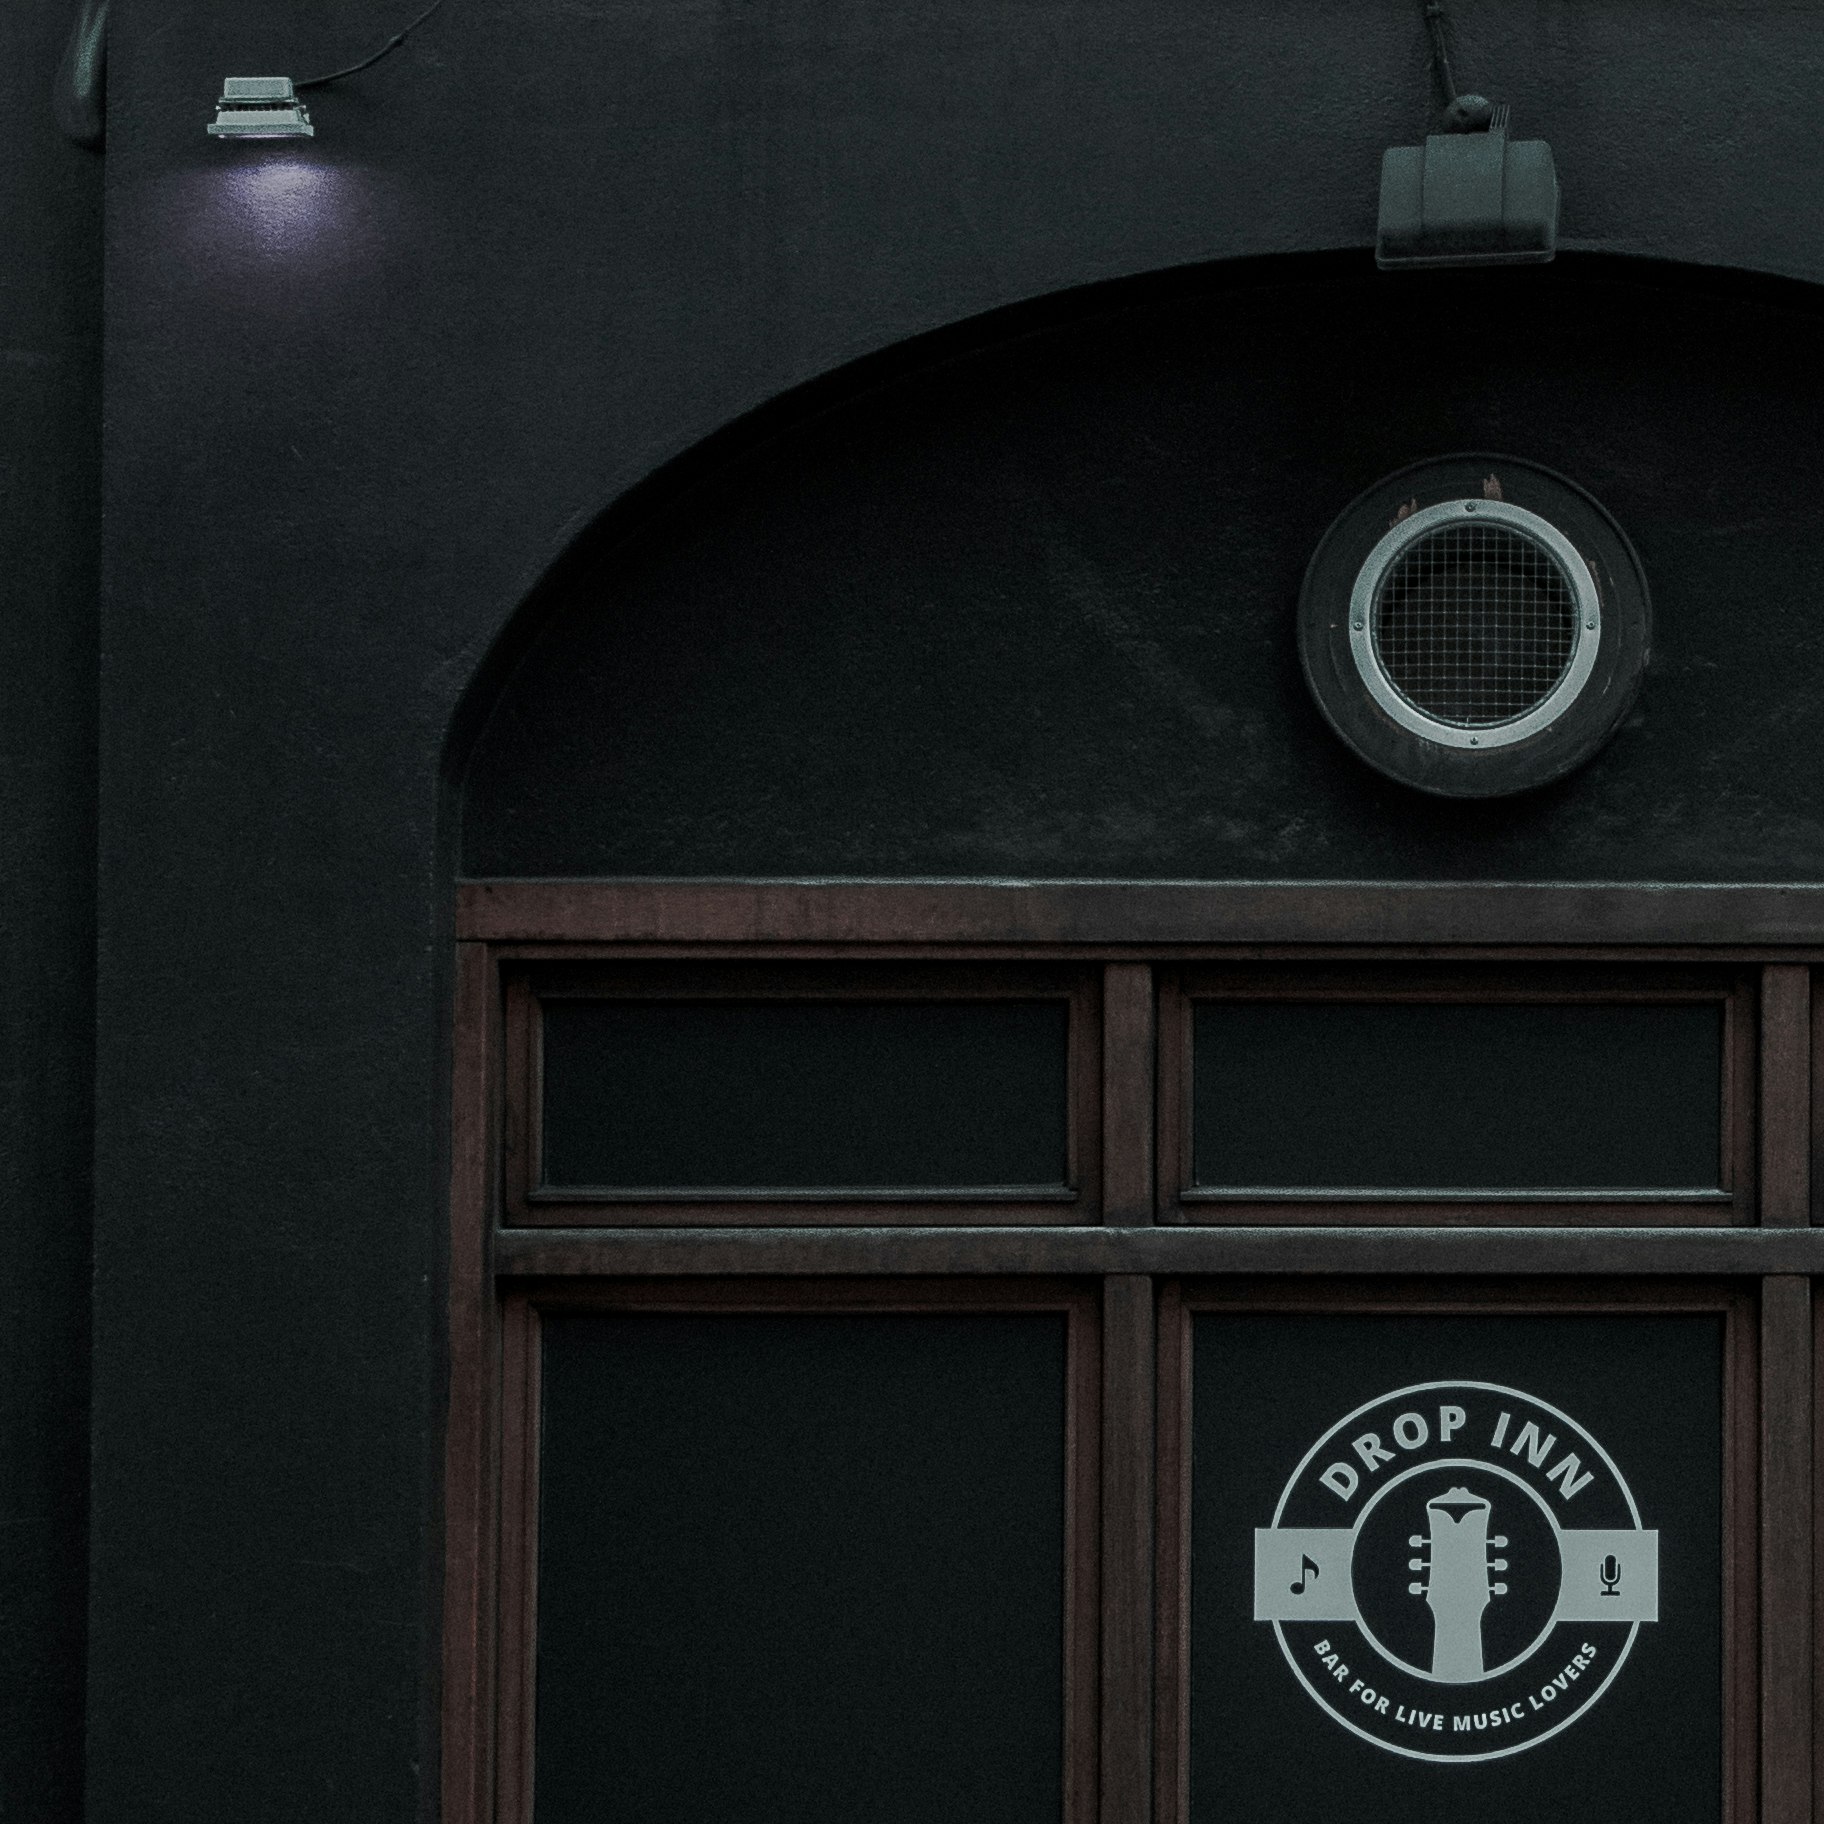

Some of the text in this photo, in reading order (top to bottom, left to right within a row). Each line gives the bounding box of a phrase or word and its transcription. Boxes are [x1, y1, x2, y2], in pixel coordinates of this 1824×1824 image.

[1318, 1405, 1595, 1503] DROP INN
[1313, 1638, 1597, 1732] BAR FOR LIVE MUSIC LOVERS
